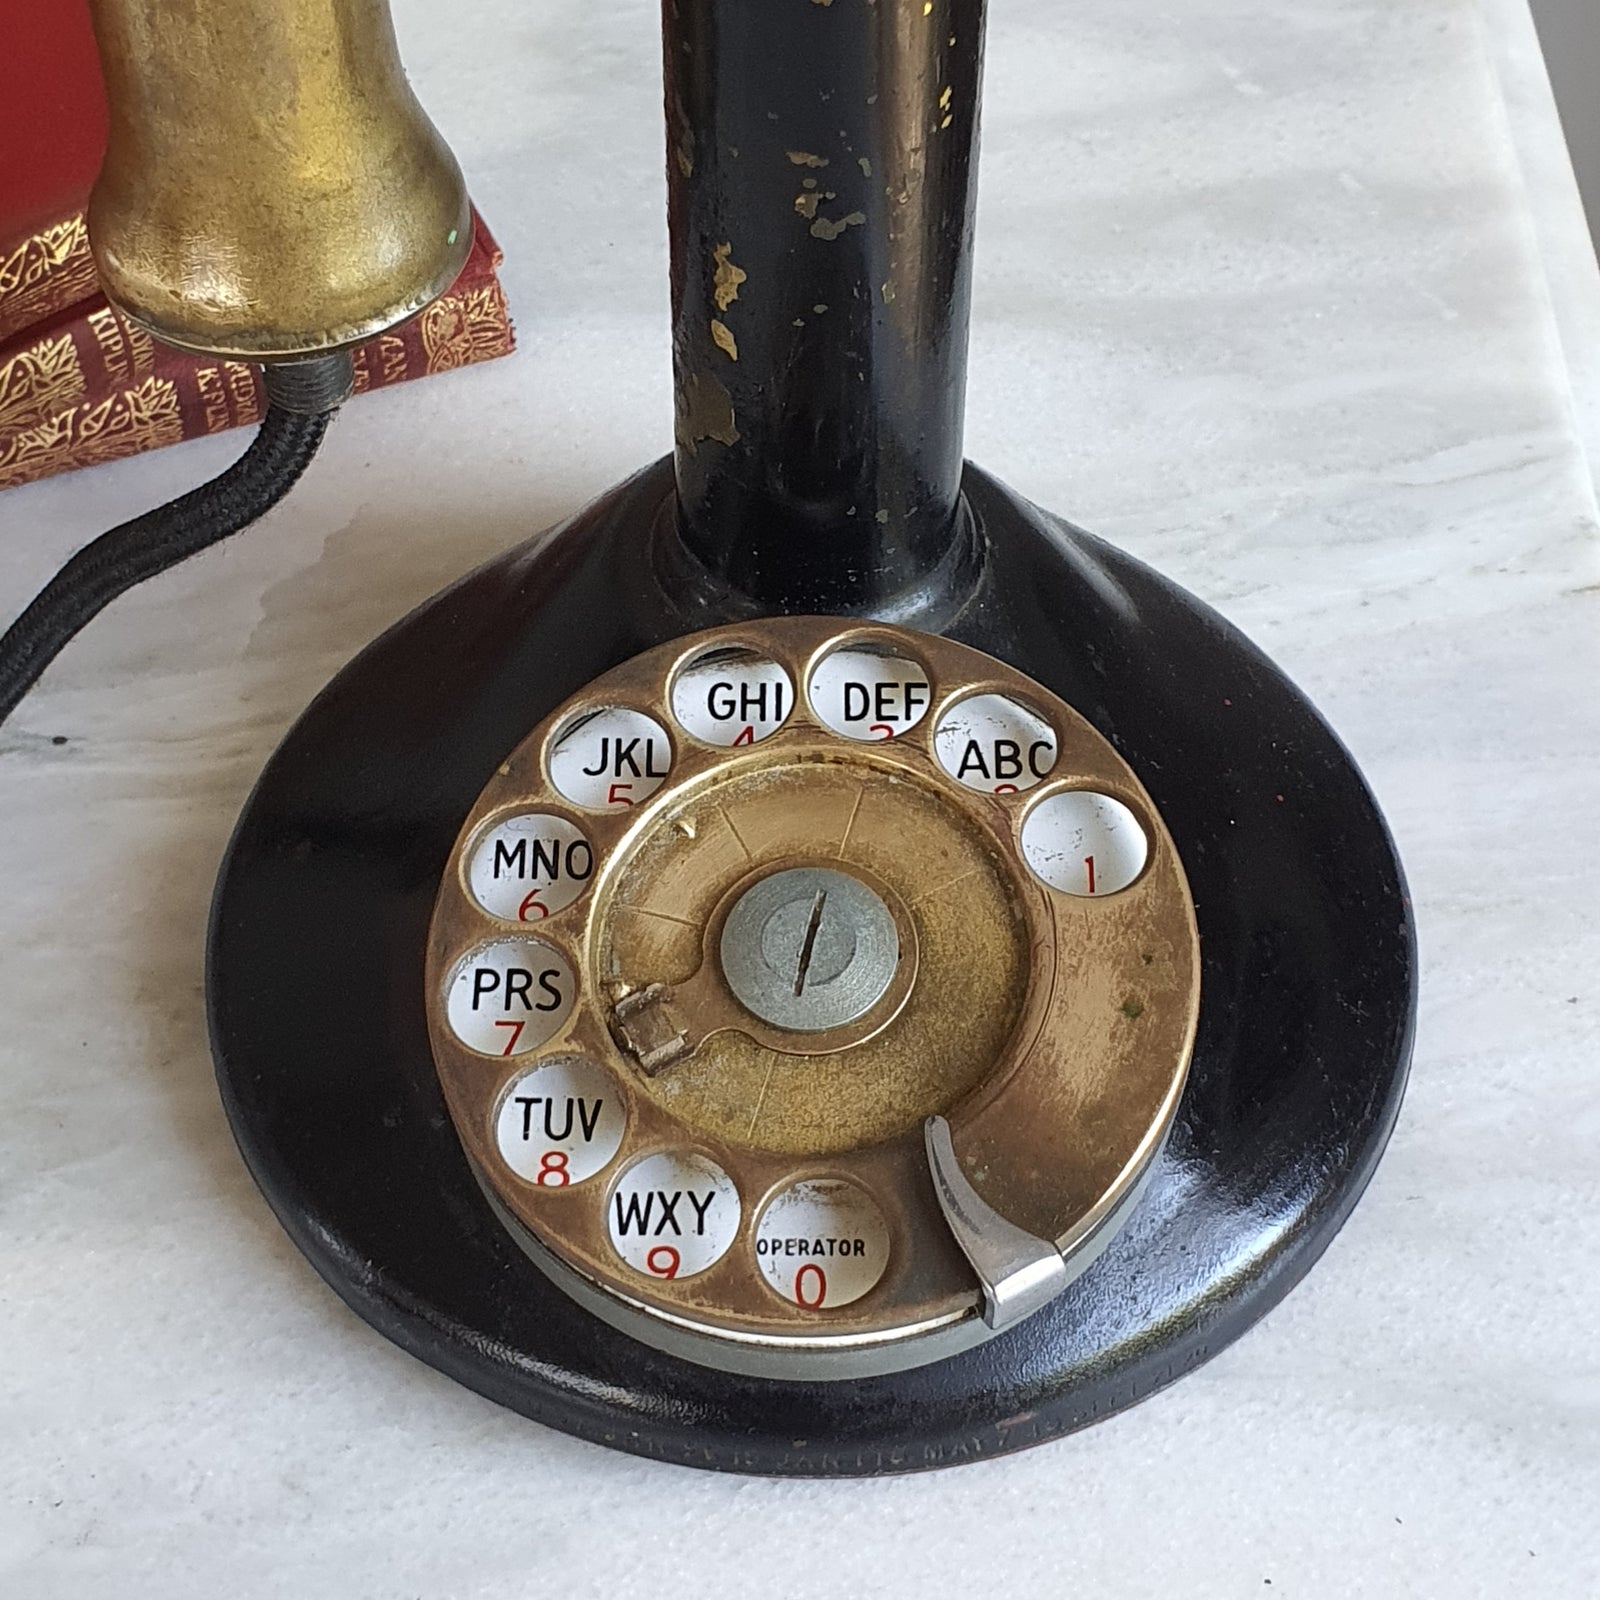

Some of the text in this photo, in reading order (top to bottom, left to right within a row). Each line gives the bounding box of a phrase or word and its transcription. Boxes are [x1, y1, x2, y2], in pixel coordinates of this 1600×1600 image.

[708, 682, 783, 722] GHI
[843, 682, 929, 722] DEF
[582, 737, 671, 778] JKL
[957, 739, 1053, 779] ABC
[493, 838, 593, 881] MNO
[1084, 855, 1096, 894] 1
[518, 888, 549, 923] 6
[472, 967, 562, 1012] PRS
[494, 1020, 526, 1057] 7
[514, 1097, 604, 1142] TUV
[537, 1150, 571, 1187] 8
[615, 1190, 717, 1237] WXY
[646, 1245, 681, 1281] 9
[756, 1238, 866, 1257] OPERATOR
